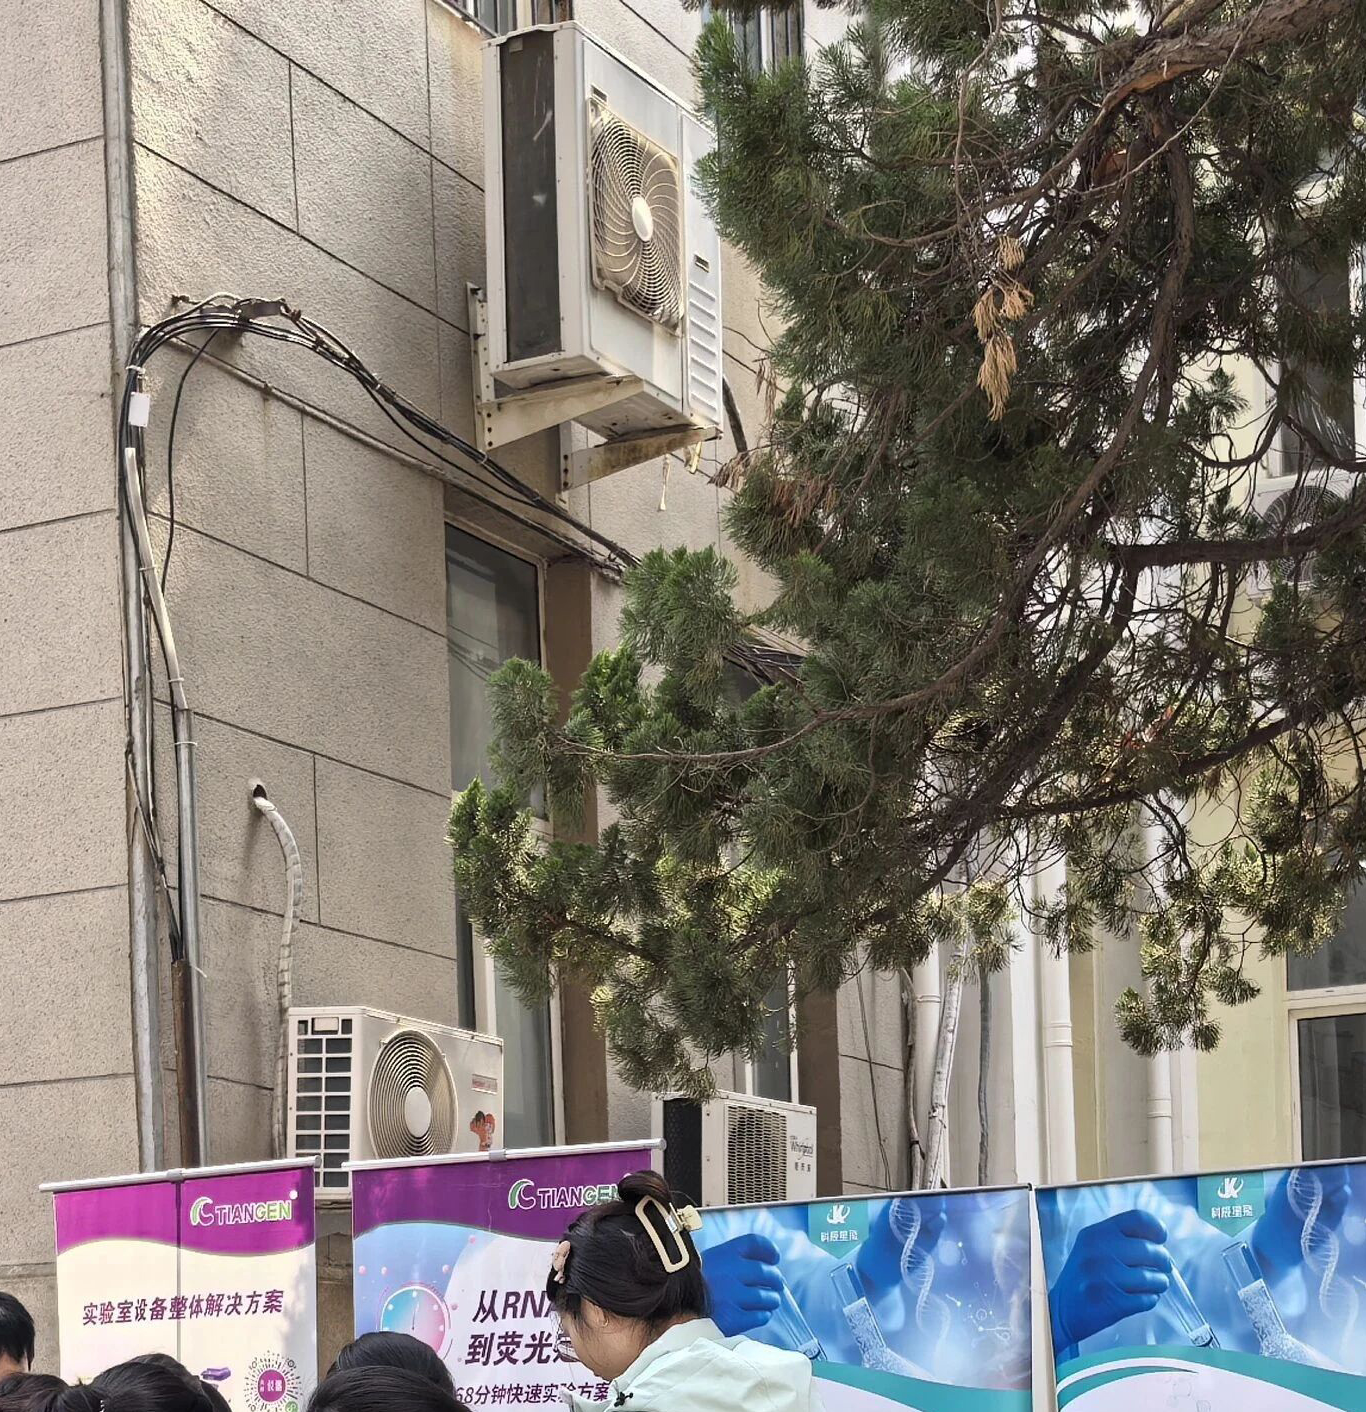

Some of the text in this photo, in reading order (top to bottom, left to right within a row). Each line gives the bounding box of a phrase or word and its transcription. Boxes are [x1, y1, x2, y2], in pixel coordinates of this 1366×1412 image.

[215, 1200, 293, 1226] TIANGEN
[82, 1289, 285, 1327] 实验室设备整体解决方案
[472, 1289, 558, 1324] 从RN
